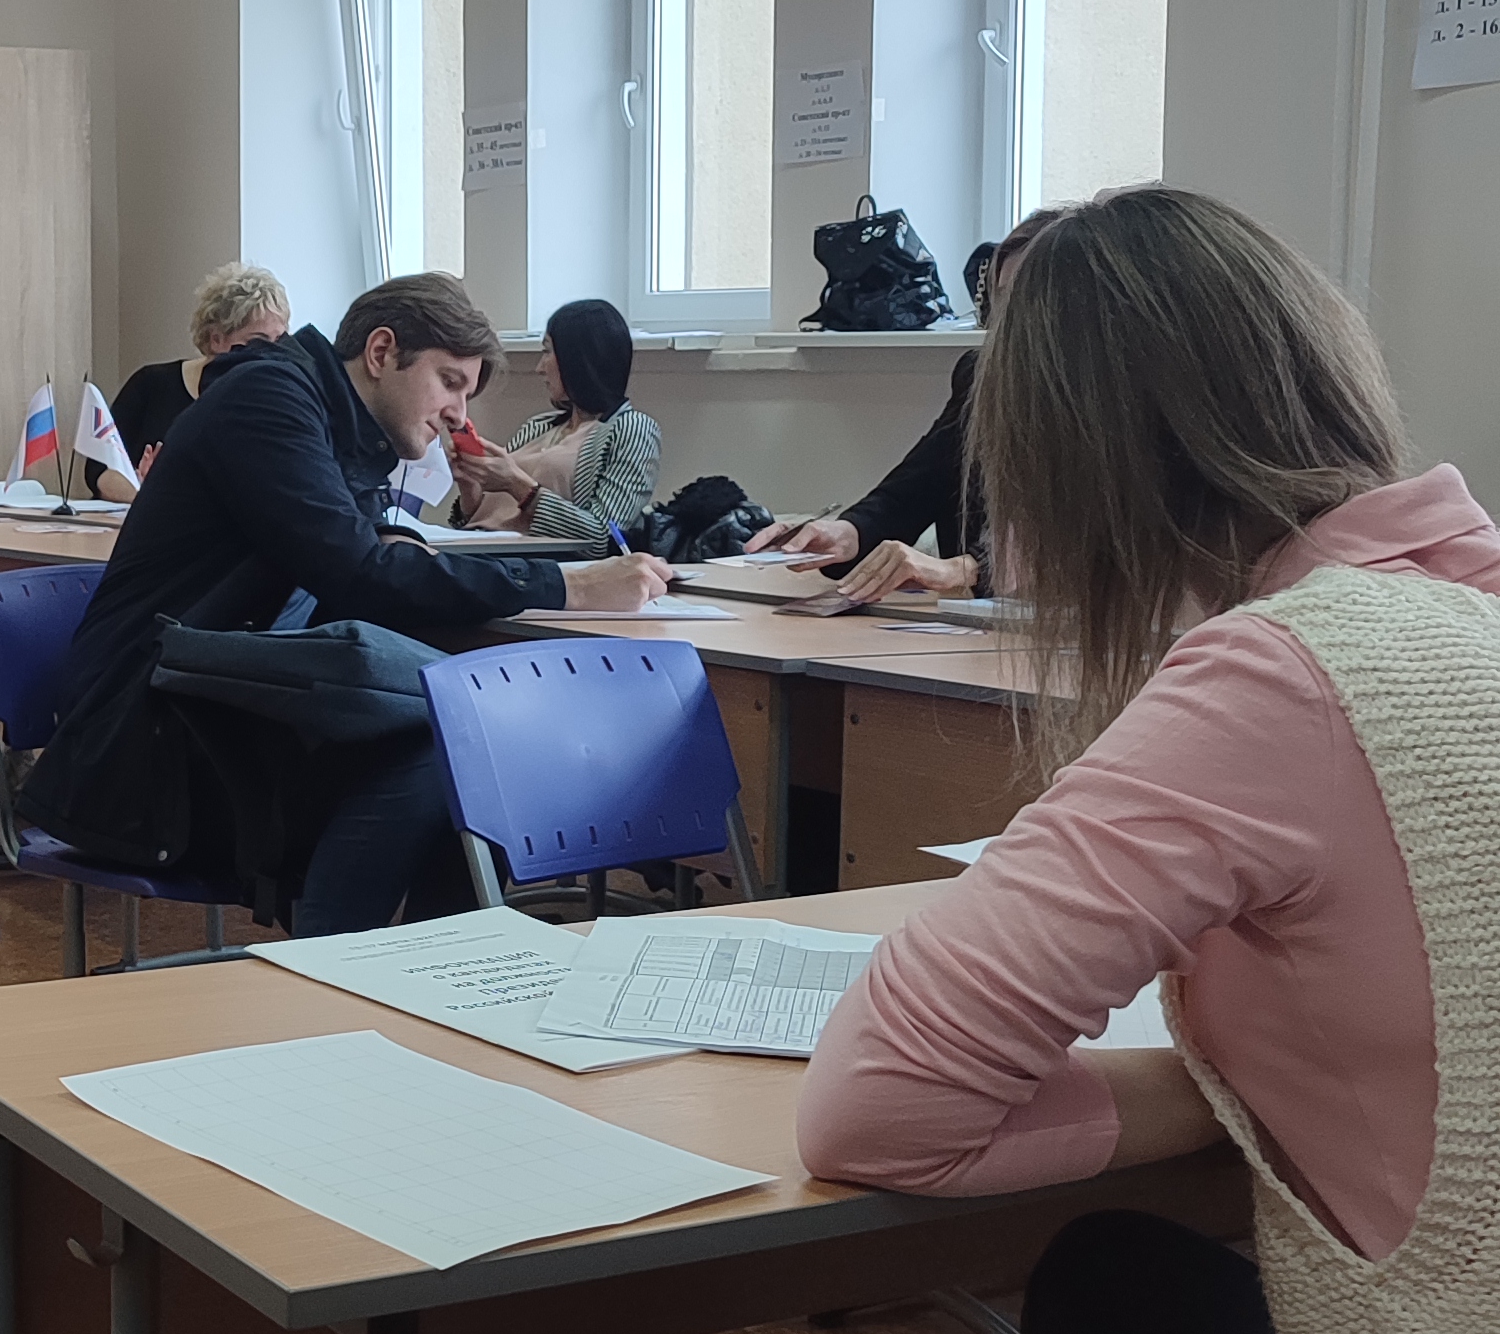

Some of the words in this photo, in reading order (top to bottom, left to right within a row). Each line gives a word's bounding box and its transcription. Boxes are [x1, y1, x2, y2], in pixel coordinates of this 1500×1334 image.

[1434, 1, 1450, 15] д.
[1430, 29, 1446, 44] д.
[1454, 22, 1464, 39] 2
[1482, 17, 1500, 36] 16
[401, 950, 541, 974] ИНФОРМАЦИЯ
[447, 960, 556, 978] кандидатах
[451, 980, 477, 989] на
[478, 967, 573, 985] должность
